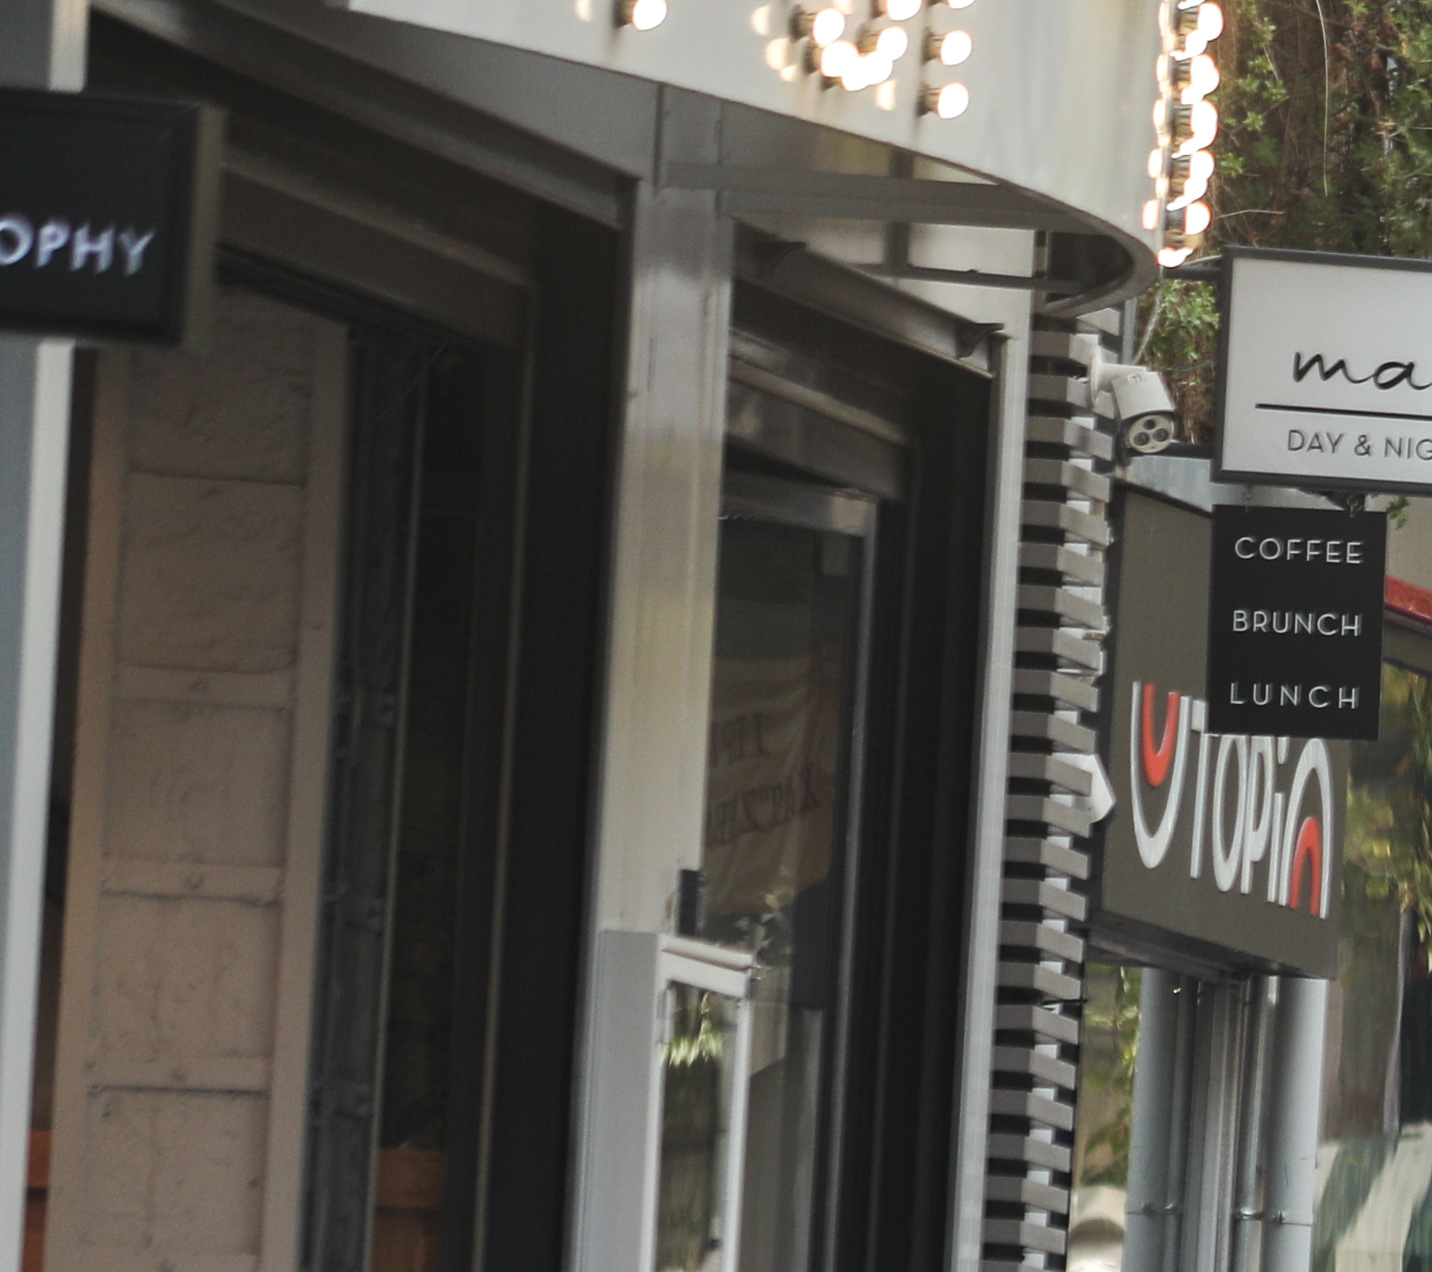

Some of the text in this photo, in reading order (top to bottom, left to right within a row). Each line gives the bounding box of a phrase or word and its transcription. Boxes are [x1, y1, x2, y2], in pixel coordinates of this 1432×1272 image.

[1287, 429, 1343, 456] DAY
[1353, 433, 1373, 457] &
[1233, 536, 1365, 565] COFFEE
[1232, 609, 1363, 637] BRUNCH
[1230, 681, 1360, 709] LUNCH
